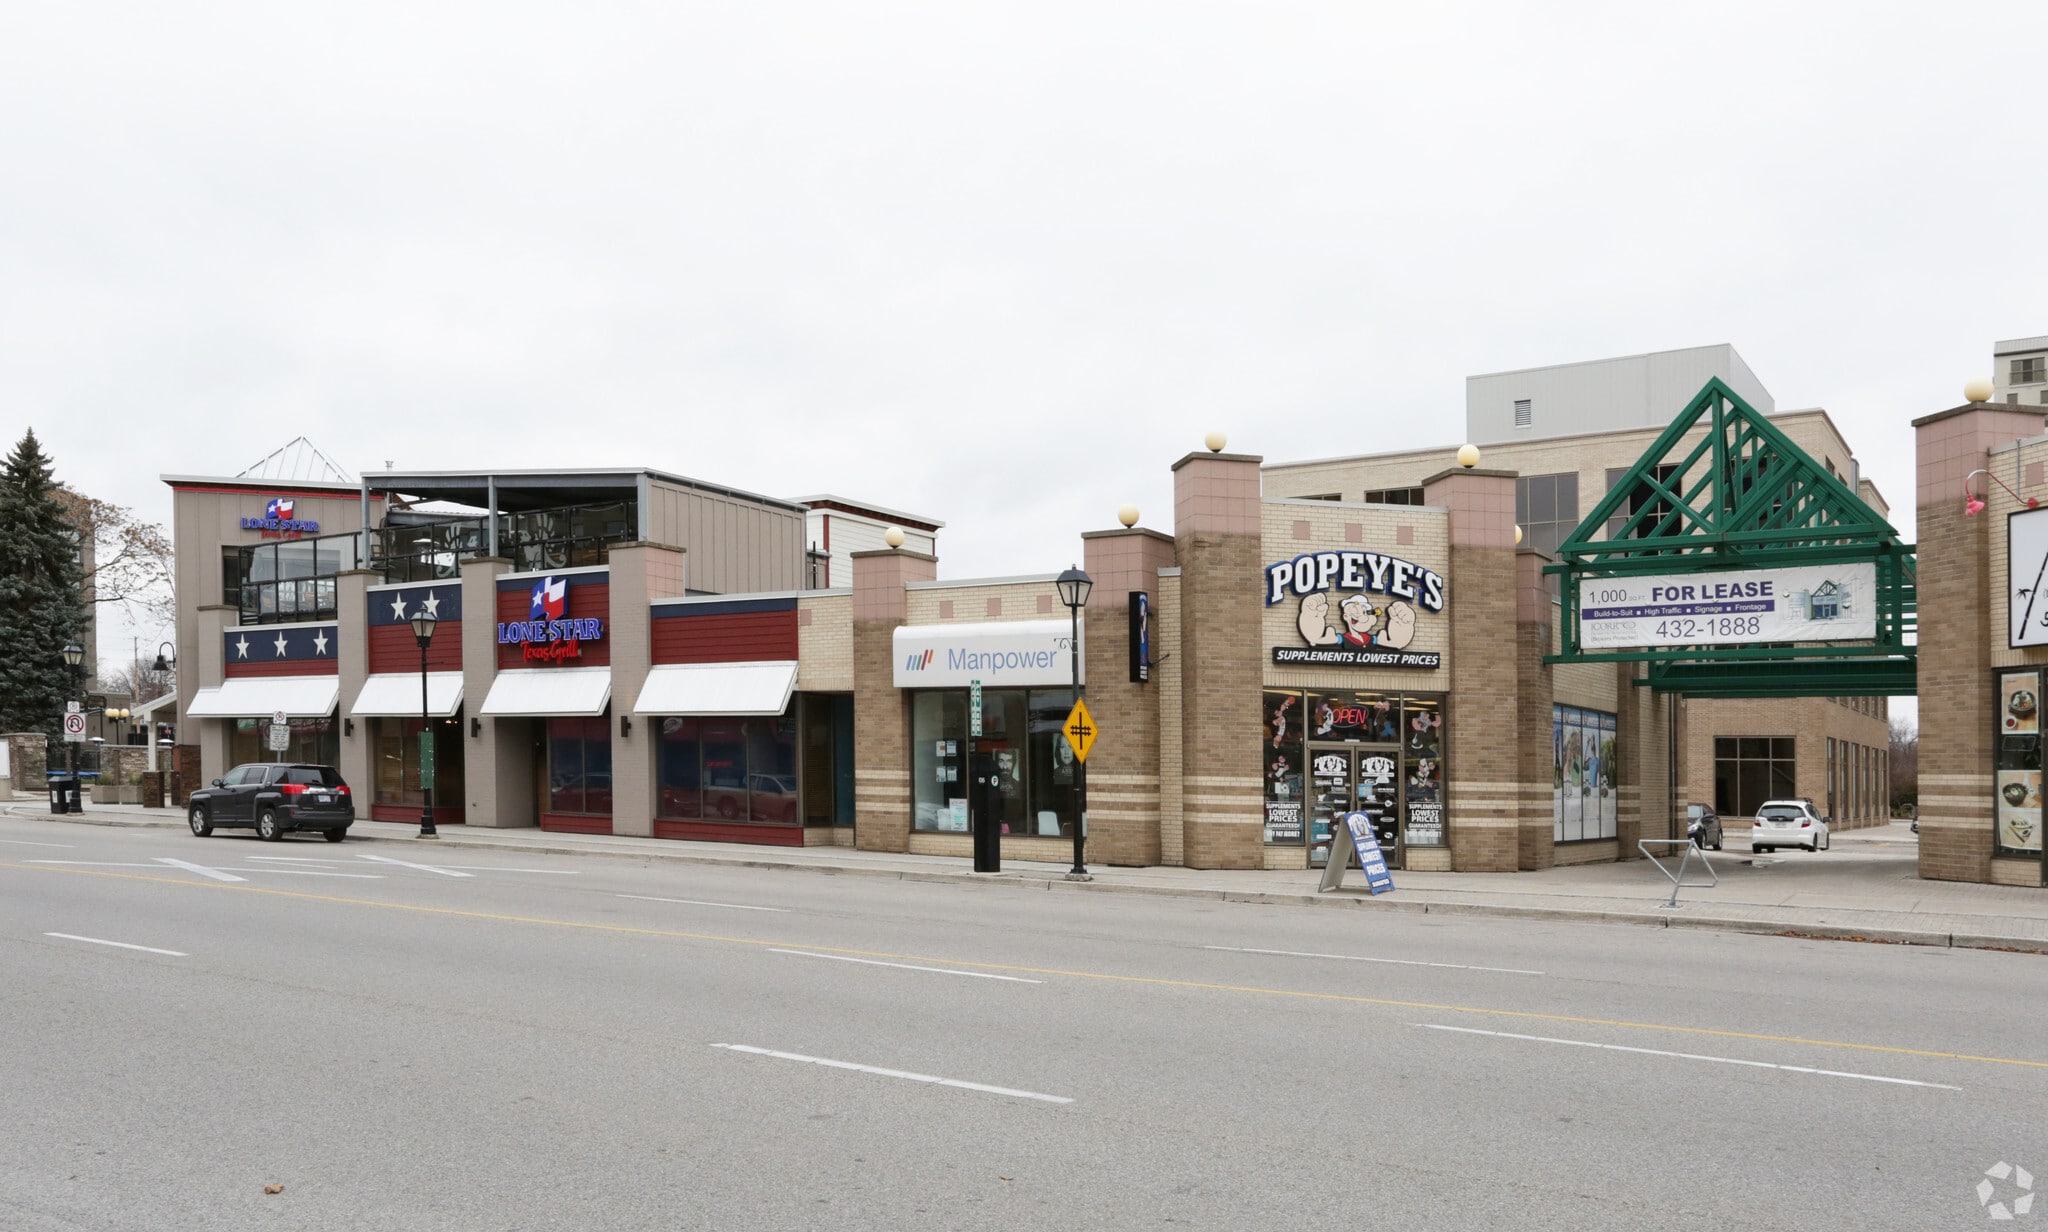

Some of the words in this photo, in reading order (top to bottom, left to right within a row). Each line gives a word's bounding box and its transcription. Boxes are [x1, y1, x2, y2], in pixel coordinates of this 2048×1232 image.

[241, 517, 279, 530] LONE
[281, 519, 319, 532] STAR
[1268, 551, 1444, 613] POPEYE'S
[1589, 589, 1627, 605] 1,000
[1652, 586, 1695, 602] FOR
[1702, 581, 1773, 600] LEASE
[1594, 609, 1633, 617] Build-to-Suit
[1644, 608, 1660, 617] High
[1661, 606, 1682, 614] Traffic
[1694, 605, 1722, 614] Signage
[1735, 603, 1766, 612] Frontage
[498, 621, 546, 644] LONE
[549, 618, 600, 641] STAR
[1655, 617, 1760, 638] 432-1888
[520, 641, 548, 662] Texas
[549, 639, 579, 664] Grill
[948, 648, 1057, 675] Manpower
[1276, 650, 1354, 662] SUPPLEMENTS
[1356, 653, 1400, 664] LOWEST
[1401, 655, 1438, 665] PRICES
[1333, 708, 1367, 724] OPEN
